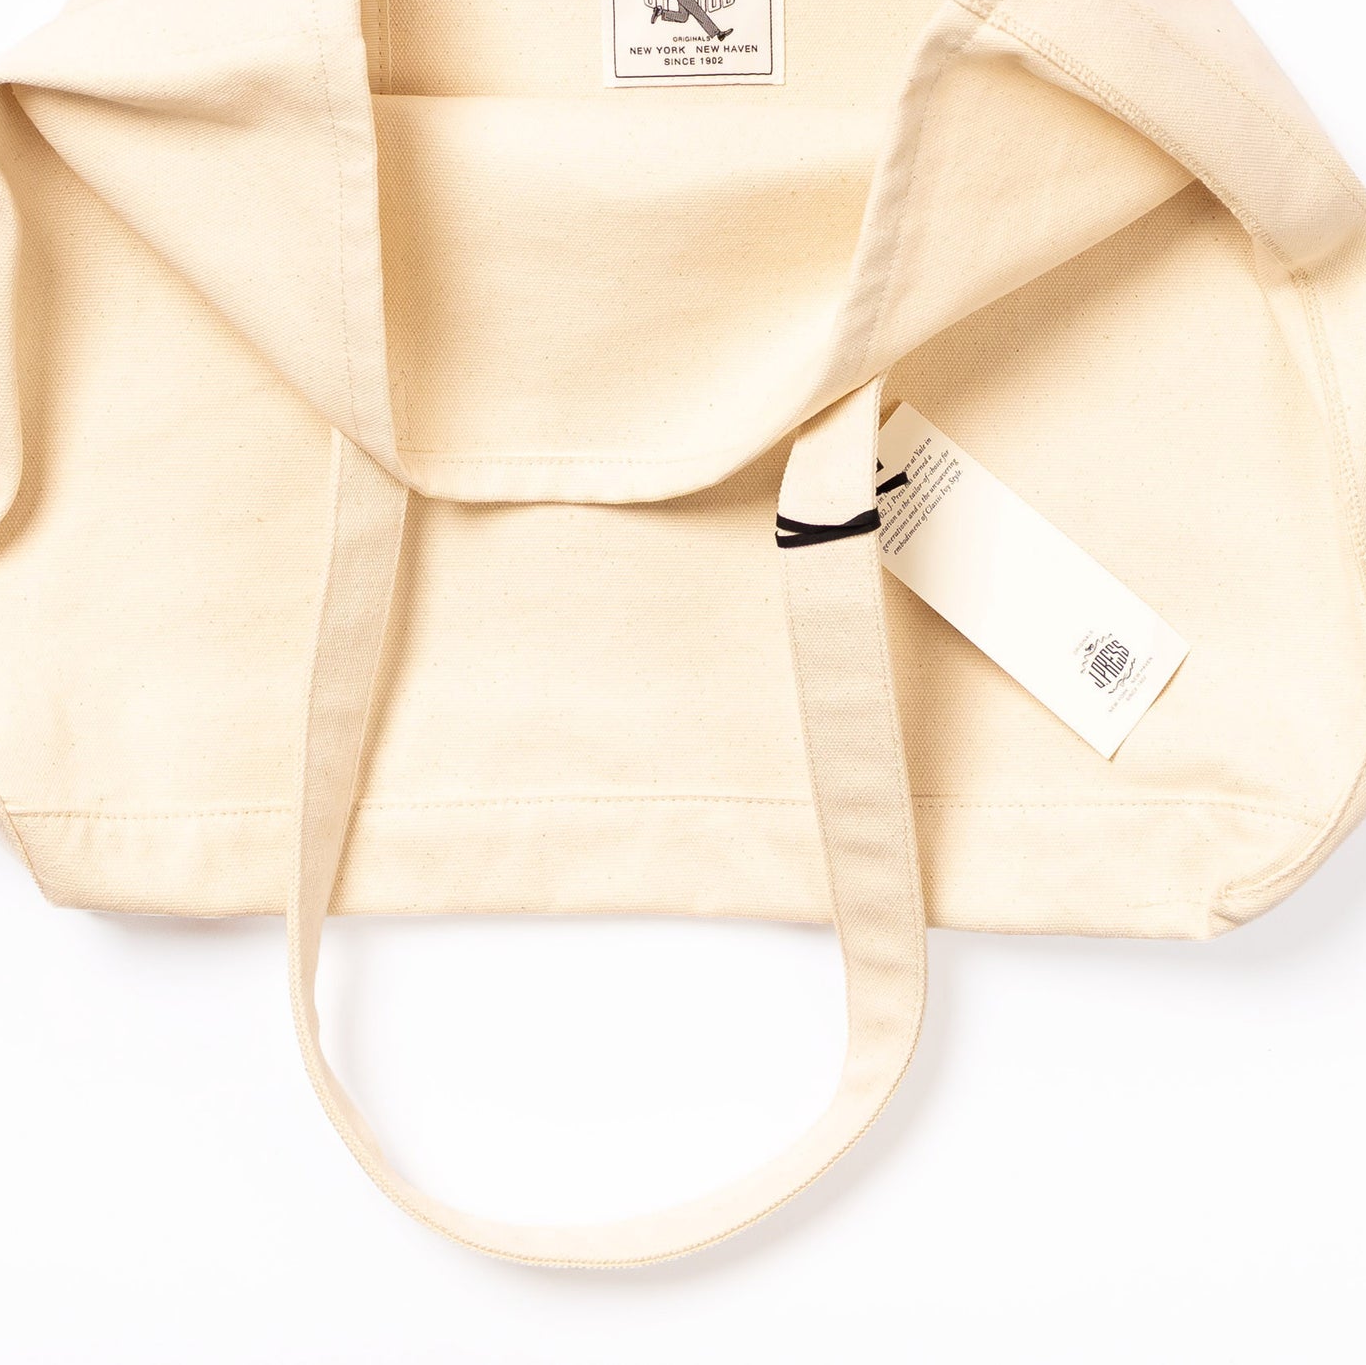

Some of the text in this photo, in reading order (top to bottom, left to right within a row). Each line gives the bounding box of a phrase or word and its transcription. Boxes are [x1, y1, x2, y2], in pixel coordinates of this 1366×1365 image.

[630, 44, 758, 55] NEW YORK NEW HAVEN
[664, 56, 723, 66] SINCE 1902
[672, 35, 711, 43] ORIGINALS
[914, 444, 926, 457] Yale
[890, 488, 905, 504] Press
[912, 457, 929, 479] earned
[900, 498, 911, 510] the
[939, 450, 951, 463] for
[881, 517, 911, 553] generations
[907, 505, 919, 519] and
[919, 490, 931, 503] the
[929, 457, 959, 493] unwavering
[892, 519, 922, 555] embodiment
[918, 510, 929, 522] of
[924, 493, 943, 514] Classic
[939, 483, 952, 496] Ivy
[1088, 639, 1130, 689] J.PRESS
